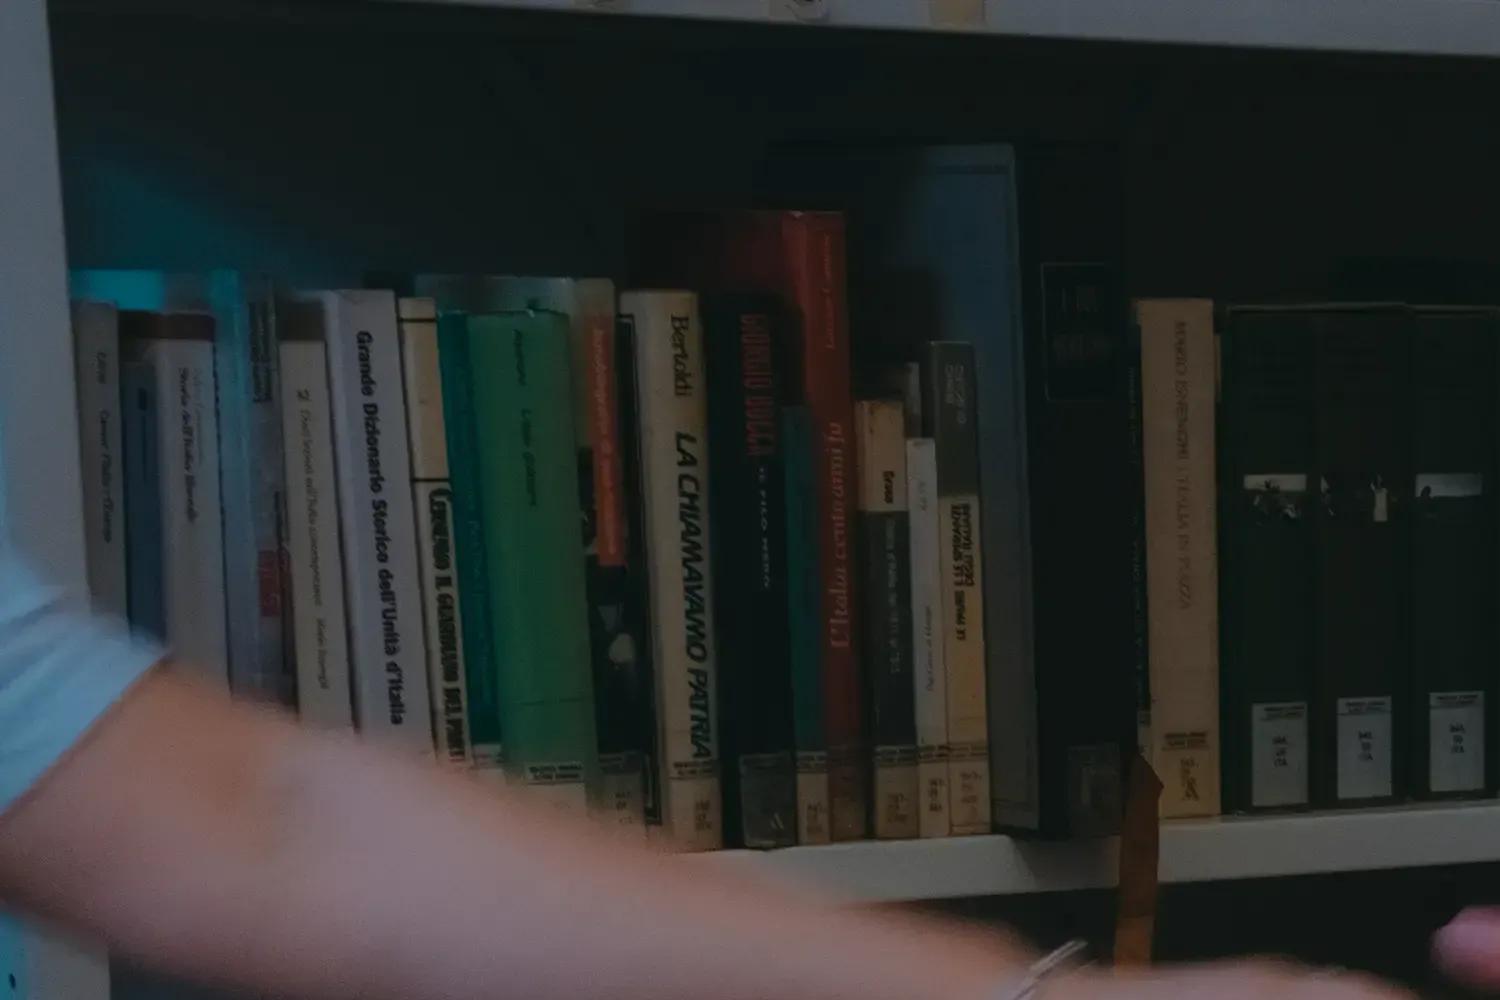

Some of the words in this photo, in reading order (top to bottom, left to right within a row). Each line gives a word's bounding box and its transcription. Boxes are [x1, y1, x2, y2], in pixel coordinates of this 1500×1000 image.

[356, 331, 374, 396] Grande
[669, 313, 693, 397] Bertoldi
[740, 313, 771, 390] GIORGIO
[363, 403, 385, 492] Dizionario
[675, 432, 698, 466] LA
[745, 396, 774, 456] BOCCA
[1174, 380, 1190, 460] ISNENGHI
[371, 499, 389, 563] Storico
[677, 474, 707, 663] CHIAMAVAMO
[376, 569, 399, 655] dell'Unità
[435, 577, 452, 591] IL
[444, 688, 461, 716] DEL
[384, 661, 406, 725] d'Italia
[687, 668, 713, 760] PATRIA
